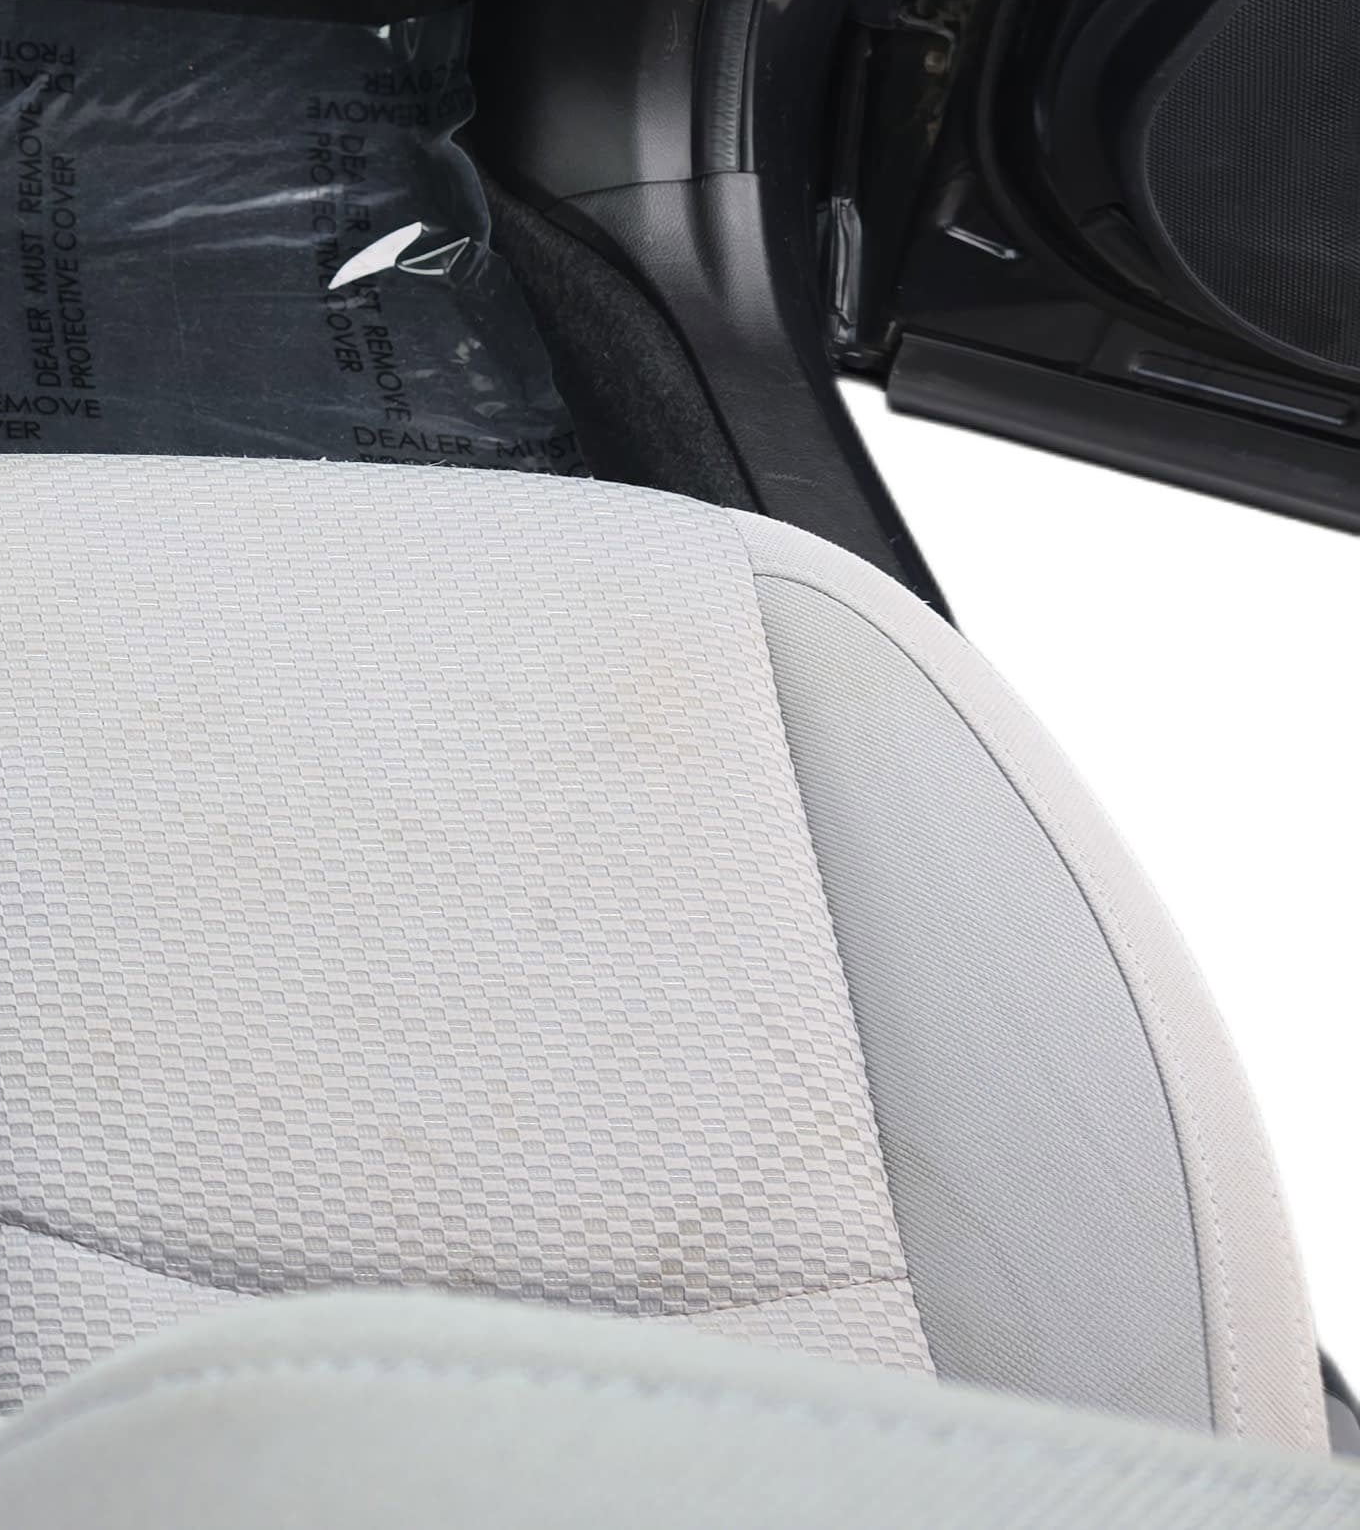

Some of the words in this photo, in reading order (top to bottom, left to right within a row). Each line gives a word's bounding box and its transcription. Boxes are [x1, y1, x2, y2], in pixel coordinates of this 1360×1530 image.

[18, 101, 42, 214] REMOVE
[51, 156, 77, 251] COVER
[21, 230, 48, 294] MUST
[350, 247, 381, 312] UST
[26, 308, 61, 387] DEALER
[54, 259, 95, 389] PROTECTIVE
[323, 295, 363, 373] COVER
[364, 326, 411, 421] REMOVE
[353, 426, 473, 455] DEALER
[497, 431, 577, 459] MUST
